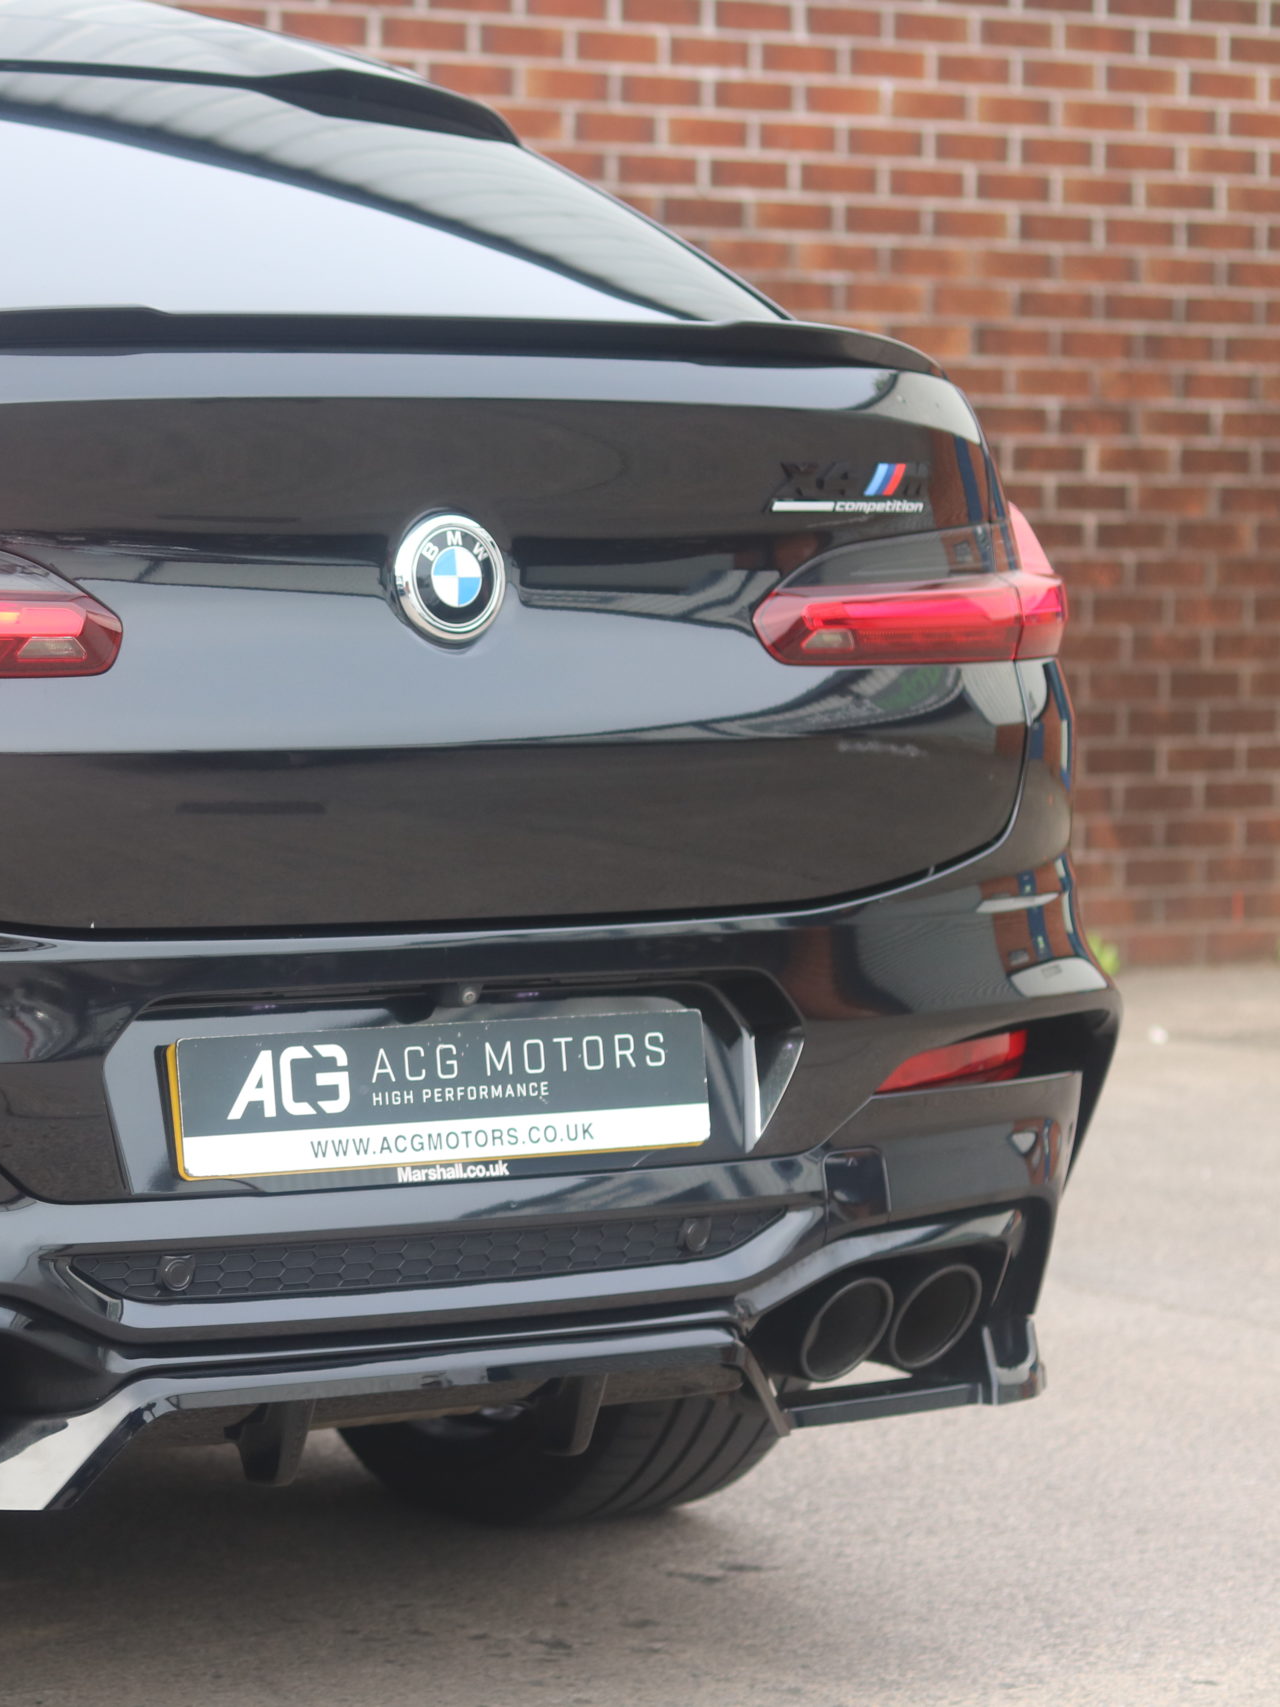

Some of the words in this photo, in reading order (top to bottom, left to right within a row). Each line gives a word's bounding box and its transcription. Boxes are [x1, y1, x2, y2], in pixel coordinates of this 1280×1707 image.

[834, 499, 924, 514] competition
[421, 530, 489, 562] BMW
[372, 1044, 458, 1083] ACG
[485, 1031, 667, 1077] MOTORS
[227, 1044, 351, 1120] ACG
[372, 1089, 414, 1106] HIGH
[422, 1081, 550, 1104] PERFORMANCE
[310, 1122, 595, 1159] WWW.ACGMOTORS.CO.UK
[396, 1160, 510, 1184] Marshall.co.uk
